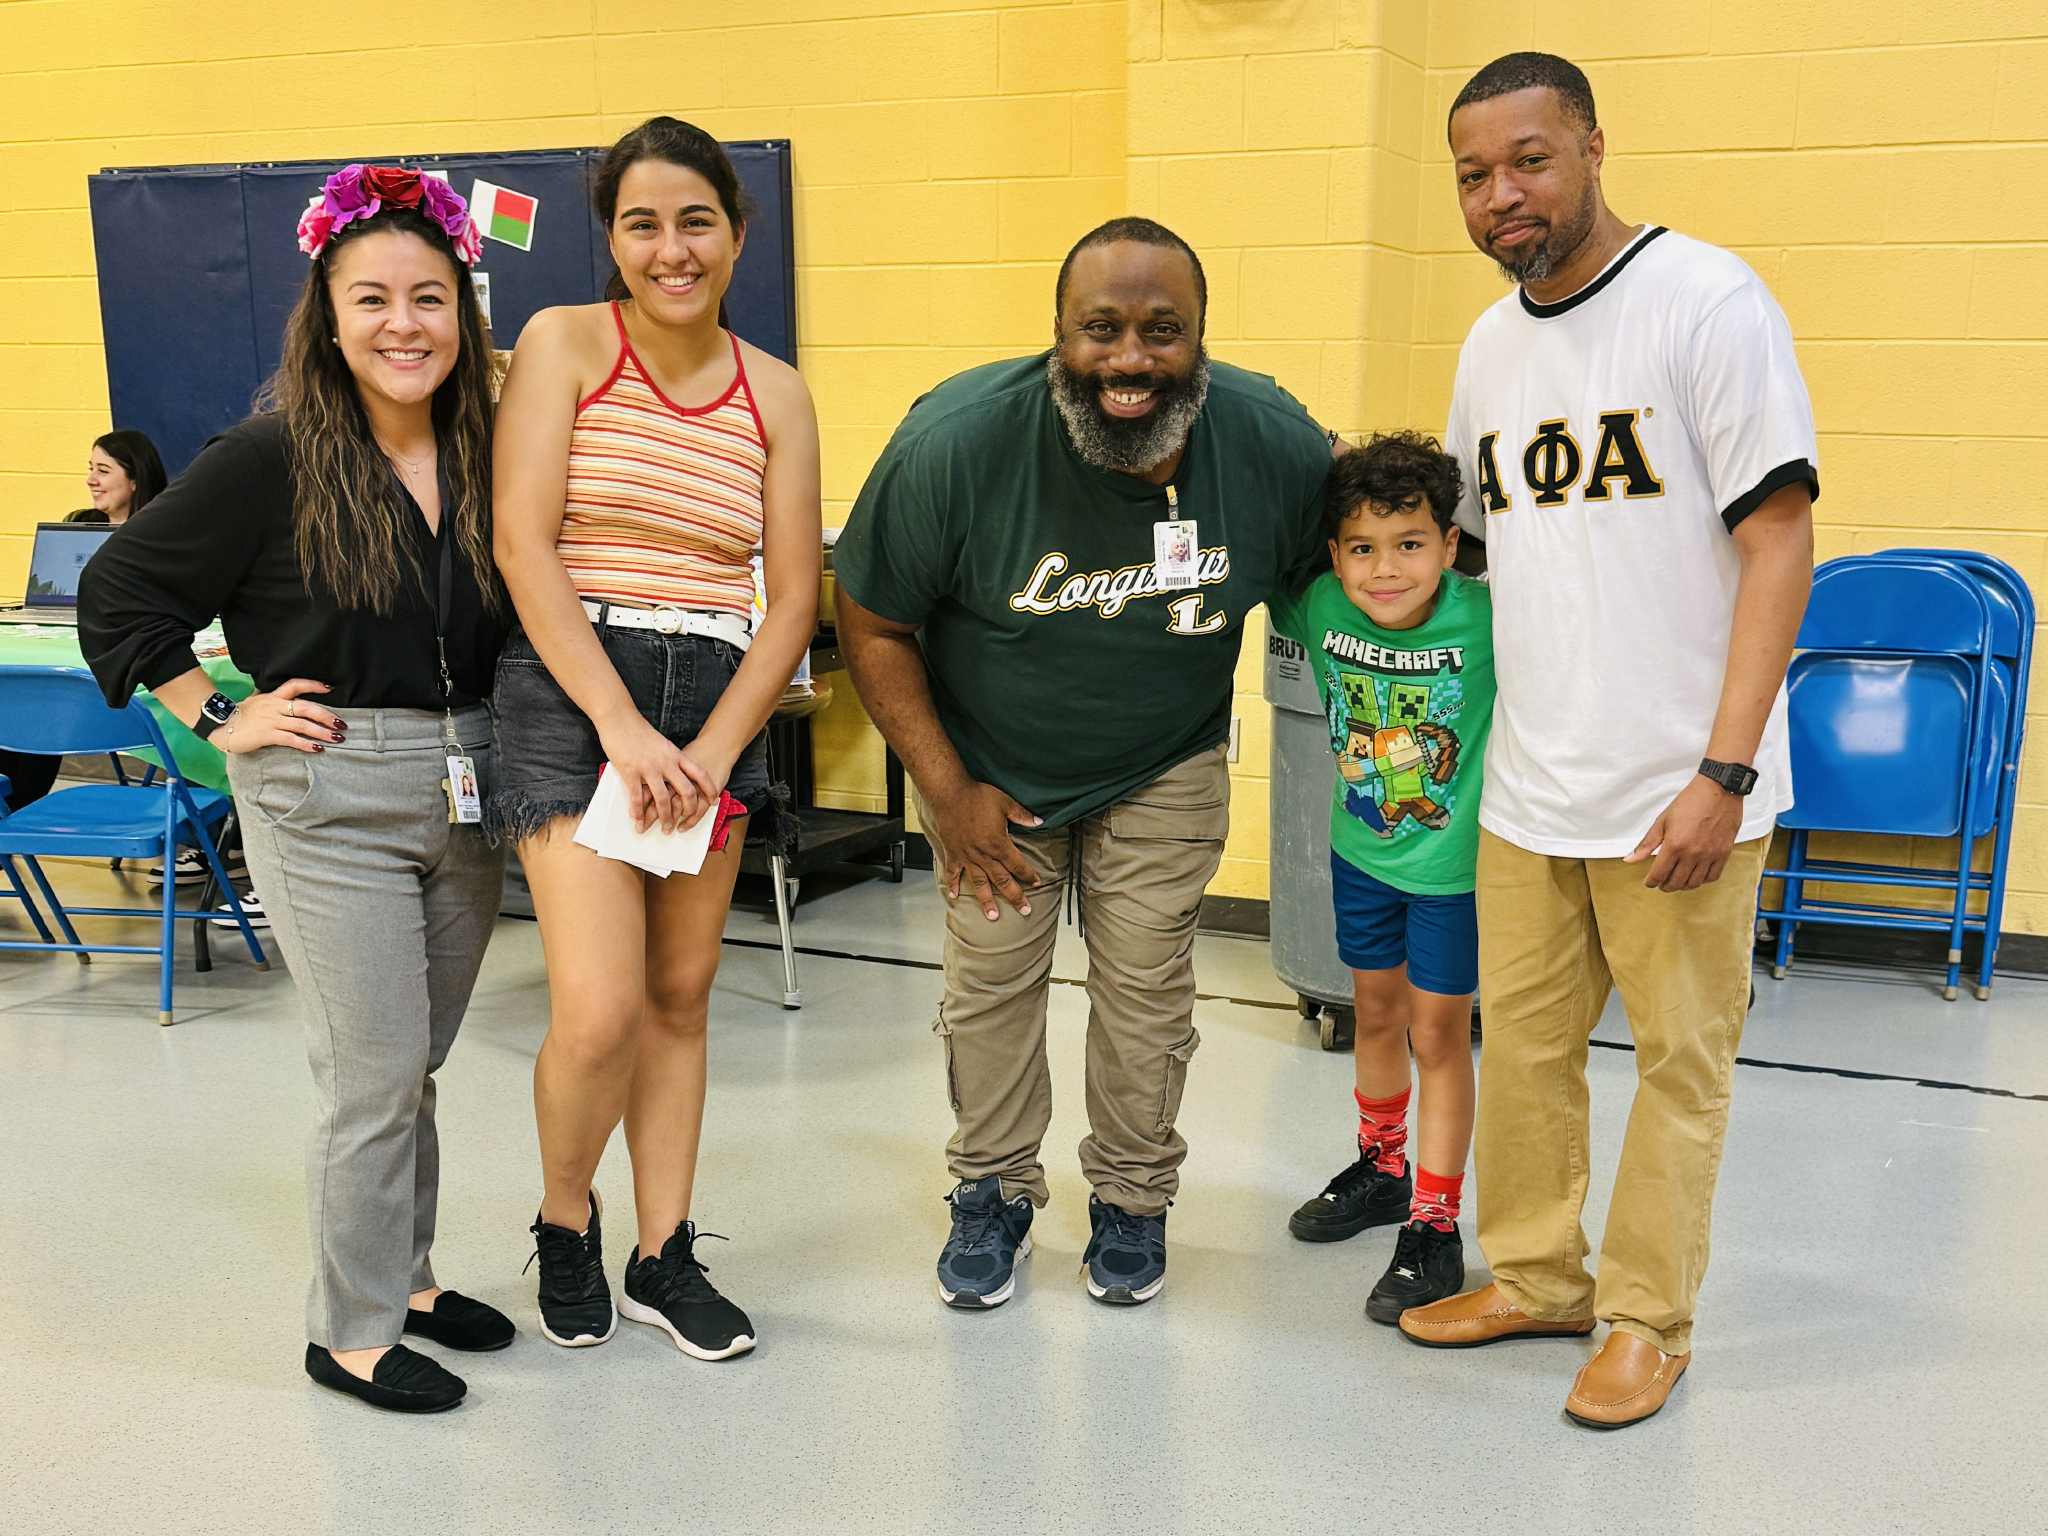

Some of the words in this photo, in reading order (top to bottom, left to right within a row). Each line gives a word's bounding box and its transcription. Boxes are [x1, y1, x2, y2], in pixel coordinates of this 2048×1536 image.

[1009, 546, 1229, 619] Longvw
[1166, 594, 1227, 635] L
[1269, 635, 1305, 661] BRUT
[1321, 629, 1464, 674] MINECRAFT
